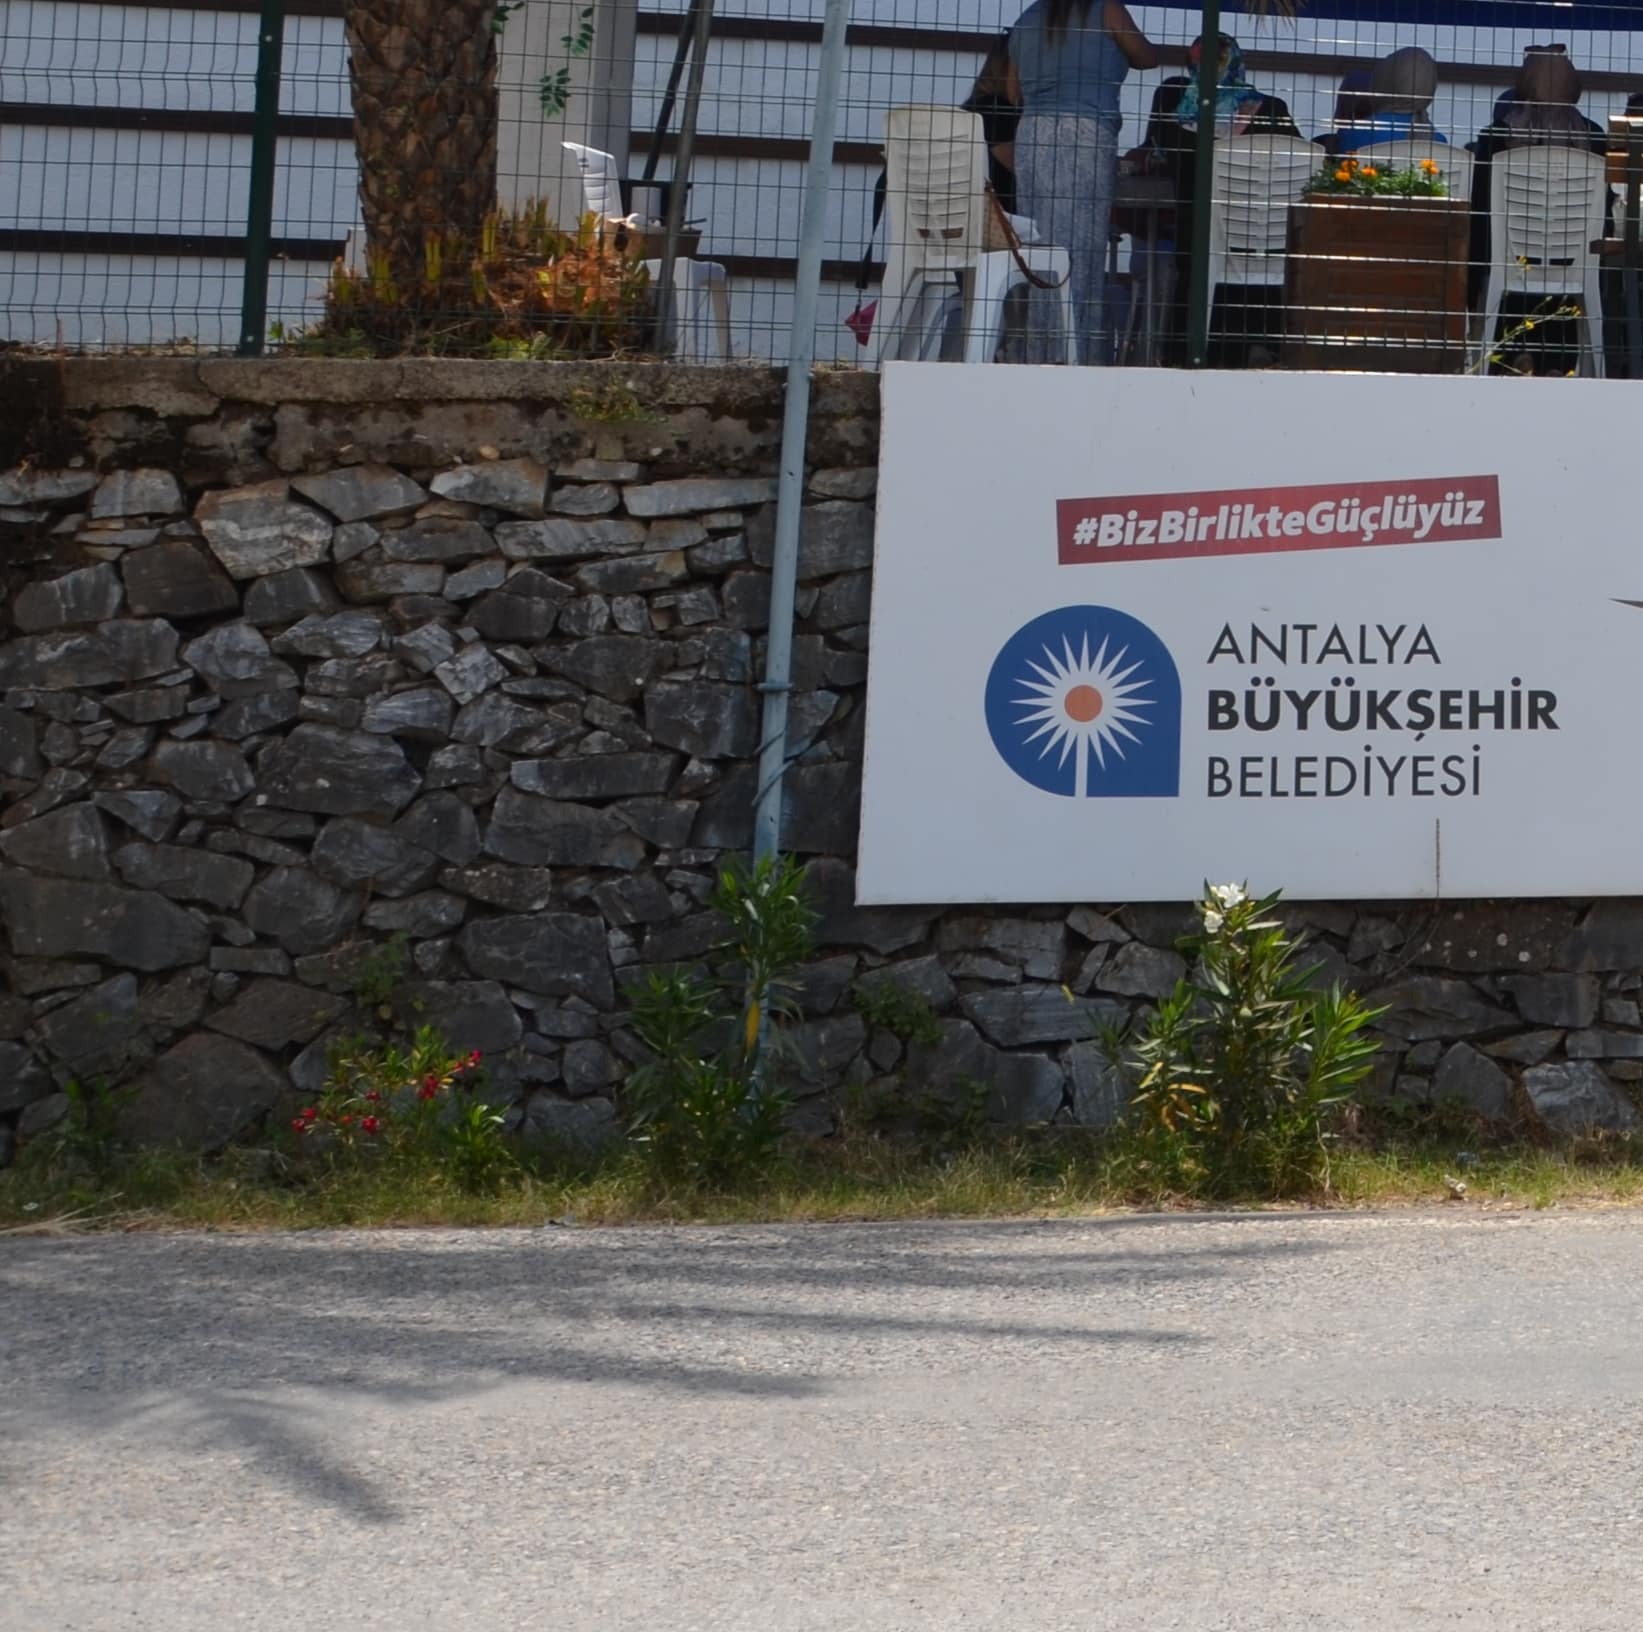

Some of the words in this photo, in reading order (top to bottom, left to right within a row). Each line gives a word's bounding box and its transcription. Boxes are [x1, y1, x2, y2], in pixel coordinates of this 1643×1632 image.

[1072, 492, 1487, 550] #BizBirlikteGüçlüyüz
[1206, 622, 1442, 666] ANTALYA
[1207, 676, 1560, 742] BÜYÜKŞEHİR
[1207, 744, 1482, 797] BELEDİYESİ
